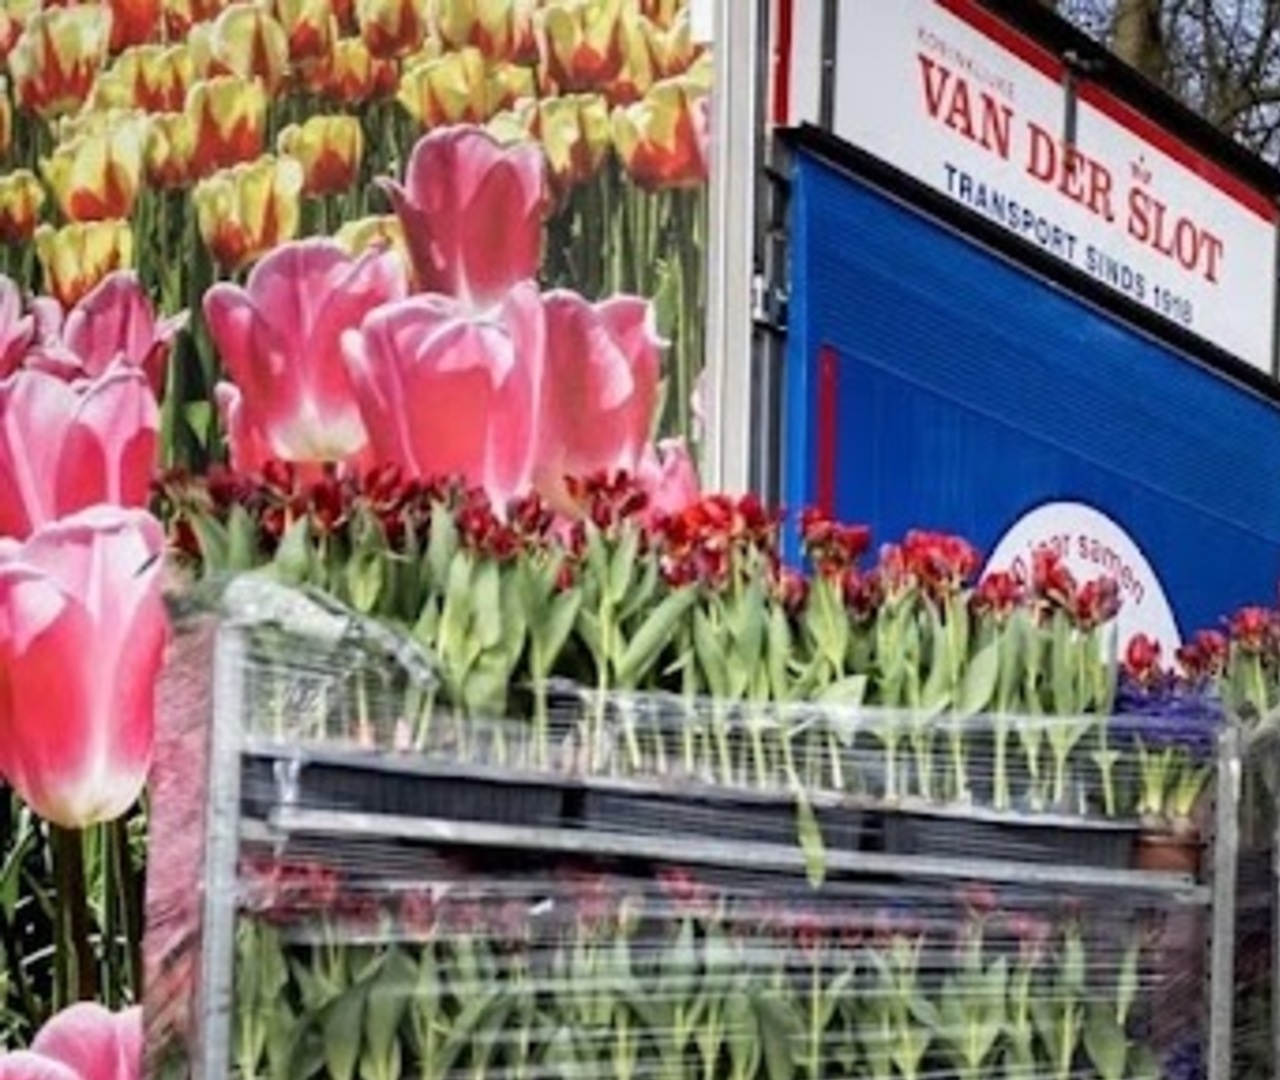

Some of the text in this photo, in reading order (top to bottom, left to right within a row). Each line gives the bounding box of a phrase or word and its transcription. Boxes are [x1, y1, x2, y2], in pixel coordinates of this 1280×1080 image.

[918, 26, 1016, 100] KONINKKE
[918, 52, 1225, 285] VAN DER SLOT
[944, 162, 1077, 260] TRANSPORT
[1086, 245, 1146, 301] SINDS
[1078, 534, 1145, 605] samen
